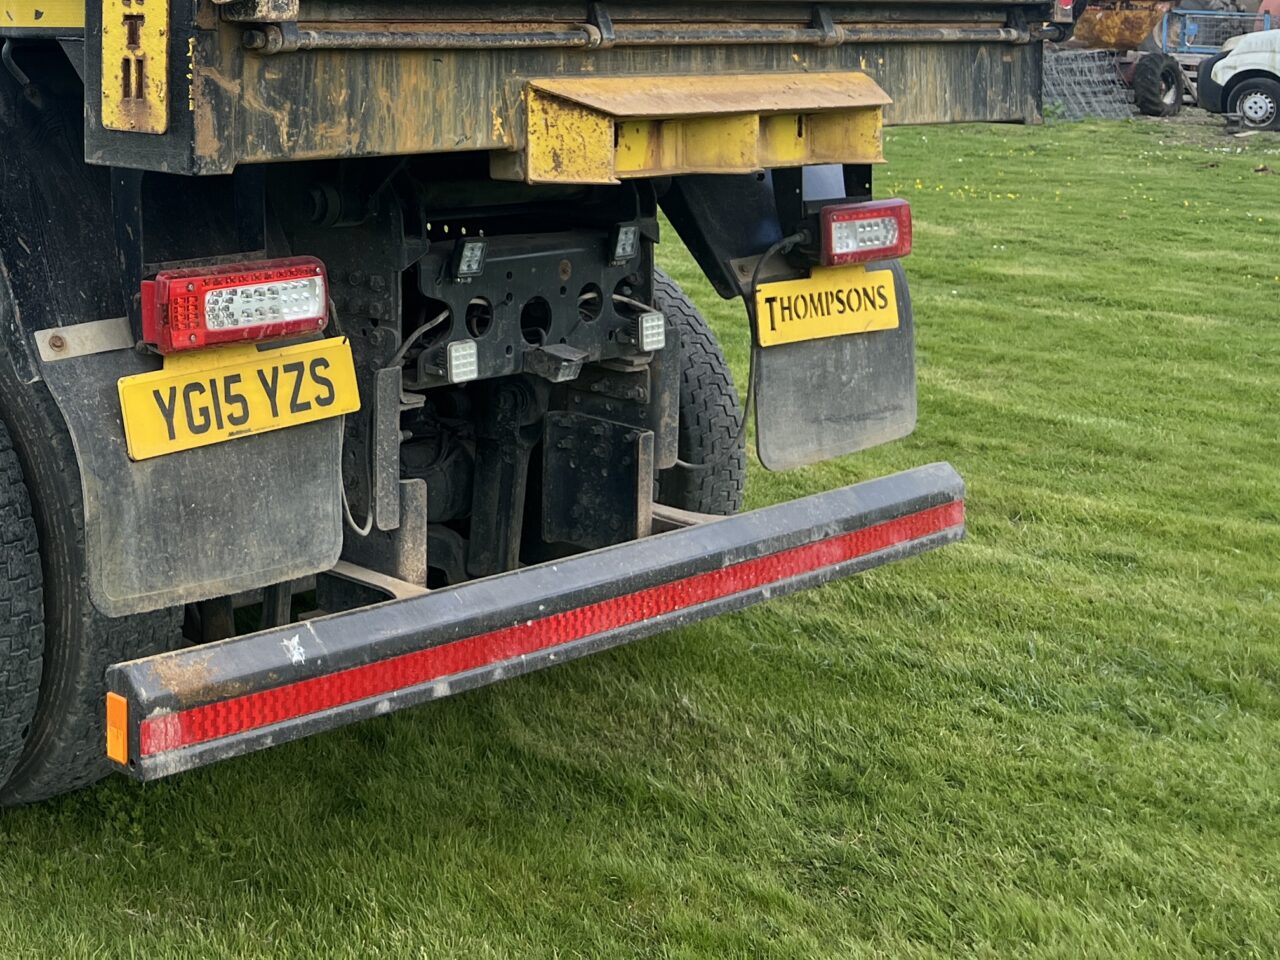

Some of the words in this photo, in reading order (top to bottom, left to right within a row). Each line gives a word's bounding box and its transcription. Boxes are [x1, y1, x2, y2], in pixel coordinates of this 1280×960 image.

[764, 284, 889, 332] THOMPSONS
[152, 373, 250, 441] YG15
[256, 357, 336, 419] YZS
